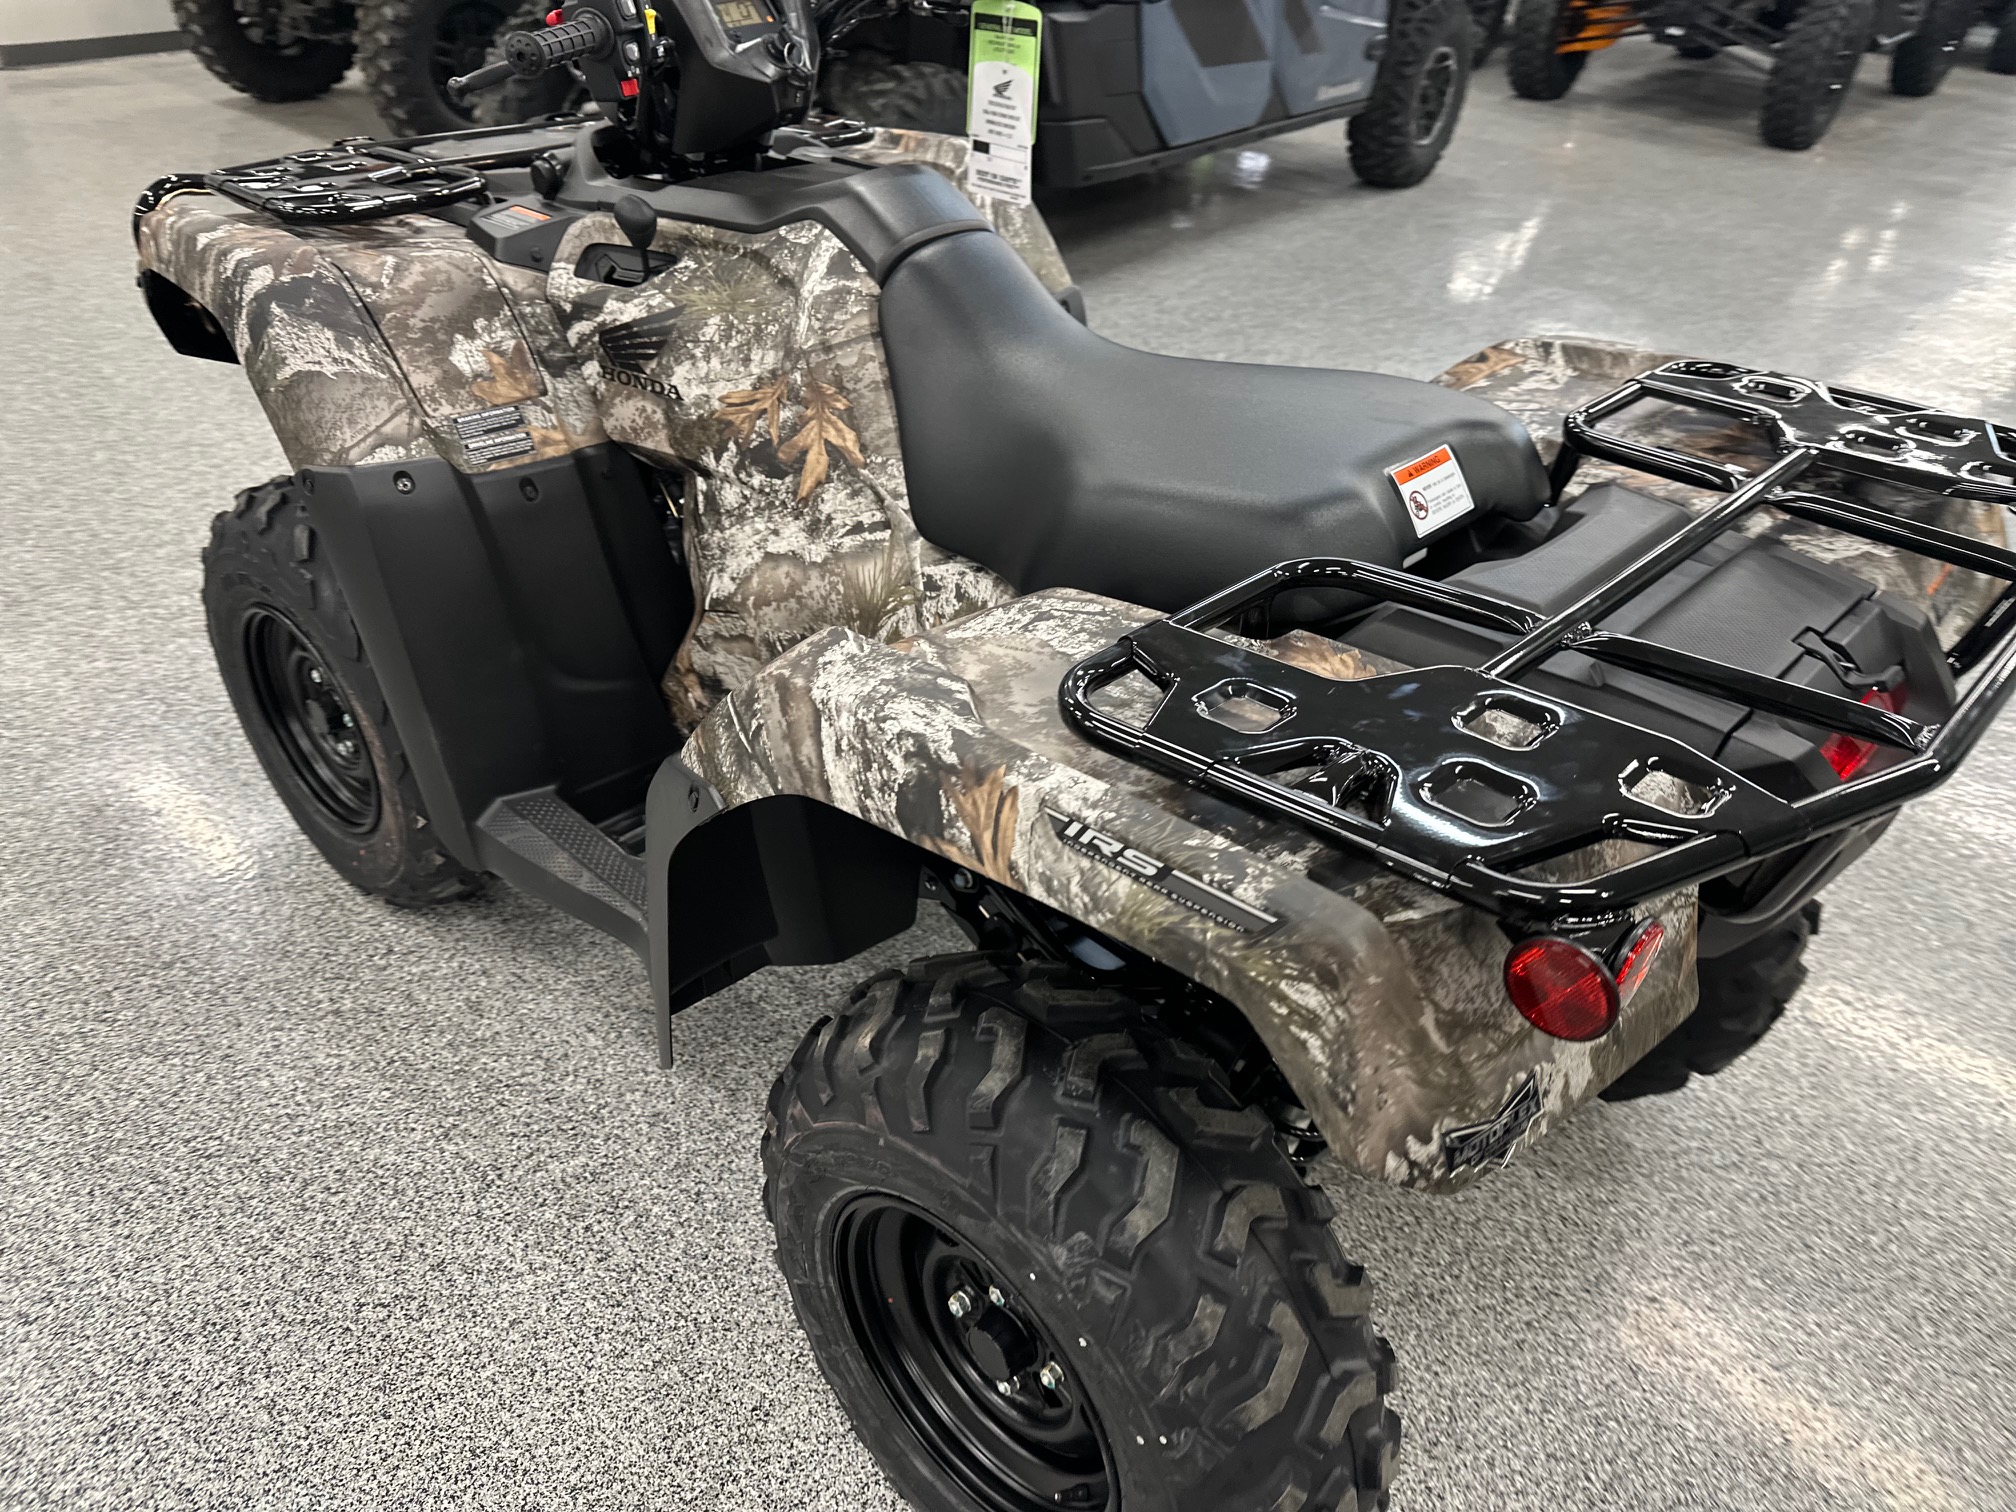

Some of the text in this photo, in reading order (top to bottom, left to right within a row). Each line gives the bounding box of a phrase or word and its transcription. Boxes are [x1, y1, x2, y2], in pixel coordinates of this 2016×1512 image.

[600, 364, 685, 402] HONDA
[1413, 455, 1441, 475] WARNING
[1063, 820, 1165, 877] IRS
